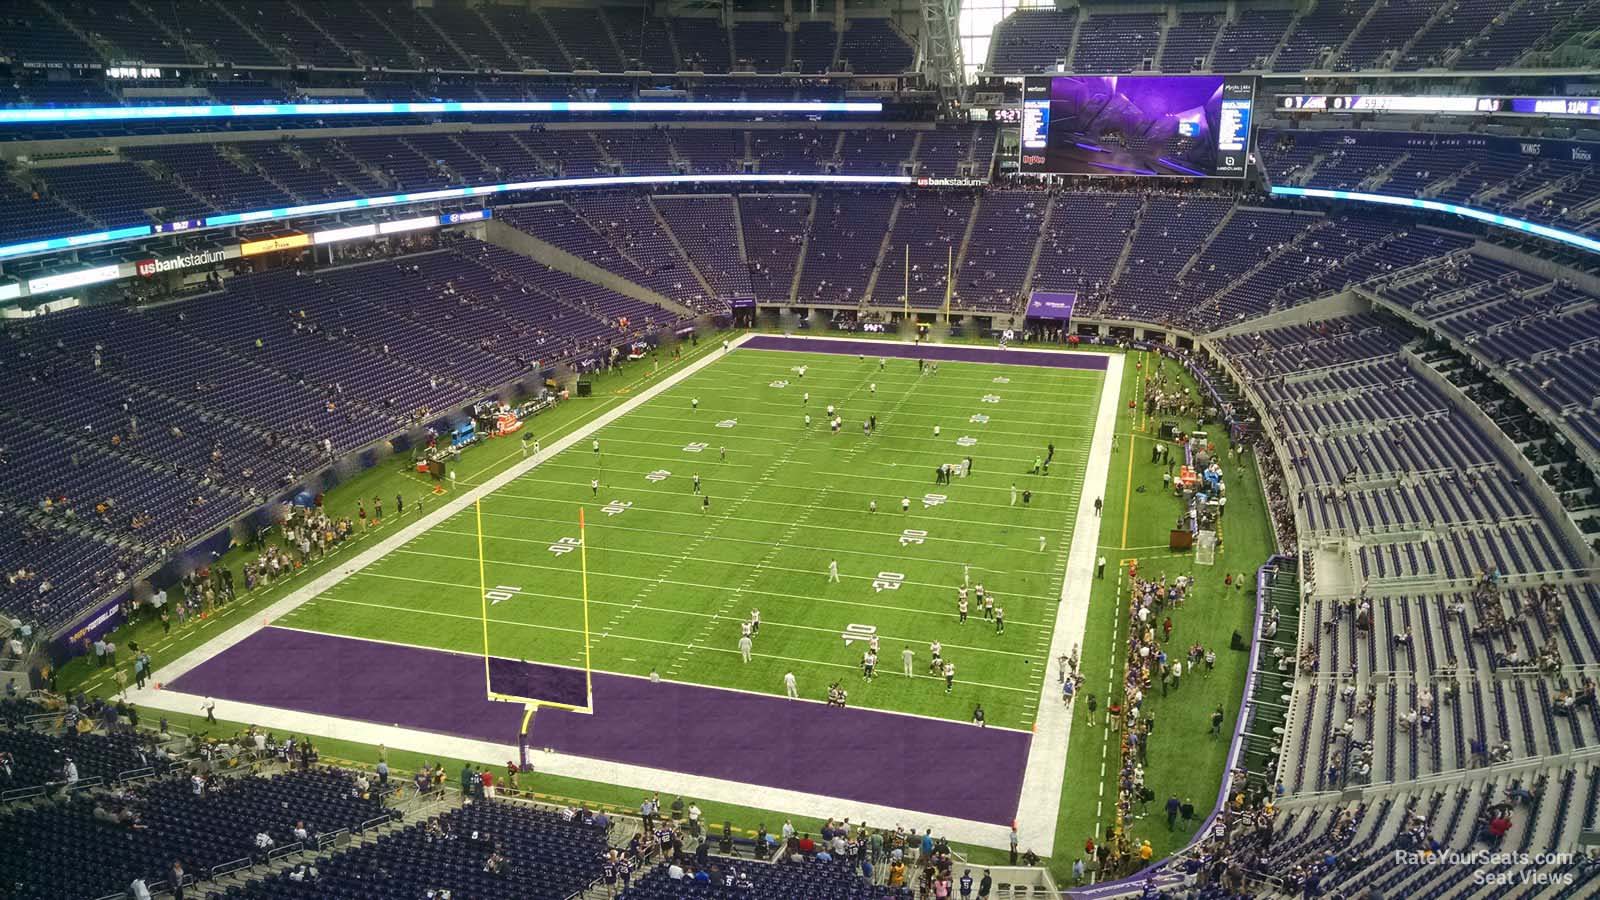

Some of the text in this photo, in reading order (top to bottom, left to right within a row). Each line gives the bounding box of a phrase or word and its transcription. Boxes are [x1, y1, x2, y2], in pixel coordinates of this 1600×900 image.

[995, 110, 1021, 120] 59:27
[899, 529, 928, 544] 30
[548, 537, 582, 553] 20
[872, 572, 905, 590] 20
[485, 586, 522, 601] 10
[841, 624, 877, 641] 10
